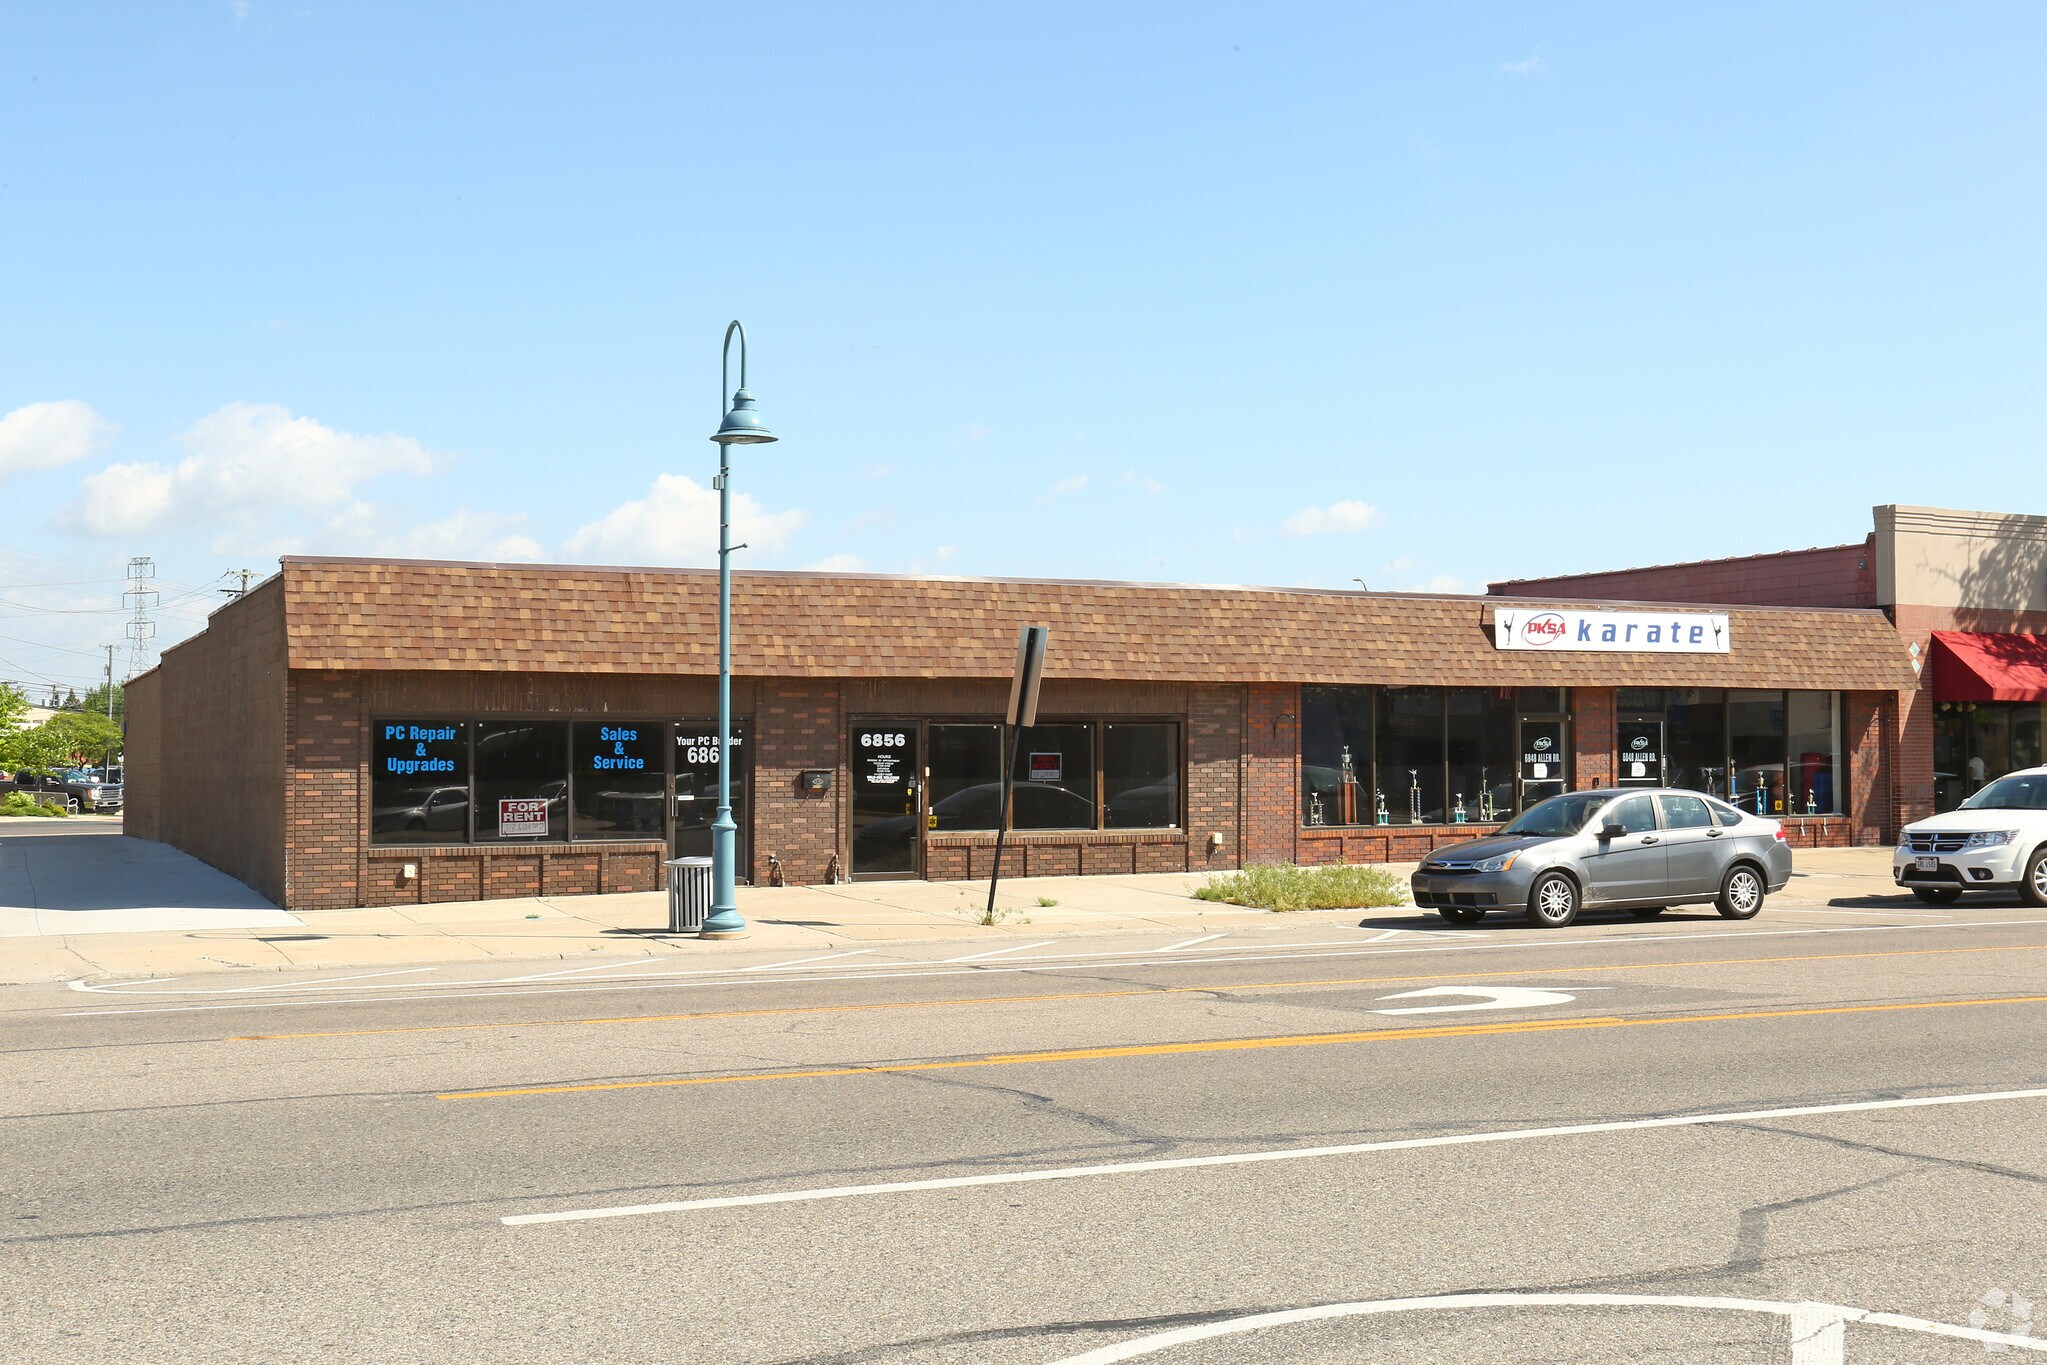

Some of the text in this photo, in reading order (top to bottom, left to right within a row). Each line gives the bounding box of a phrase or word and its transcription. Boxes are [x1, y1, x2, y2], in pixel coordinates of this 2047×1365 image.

[1527, 618, 1567, 641] PKSA
[1577, 619, 1704, 644] karate
[385, 726, 456, 742] PC Repair
[600, 726, 637, 741] Sales
[860, 733, 906, 747] 6856
[614, 741, 625, 755] &
[676, 736, 743, 746] Your PC Bder
[415, 742, 427, 757] &
[593, 755, 644, 770] Service
[1538, 753, 1552, 763] ALLEN
[1635, 752, 1648, 762] ALLEN
[387, 757, 455, 775] Upgrades
[508, 802, 539, 812] FOR
[503, 812, 544, 822] RENT
